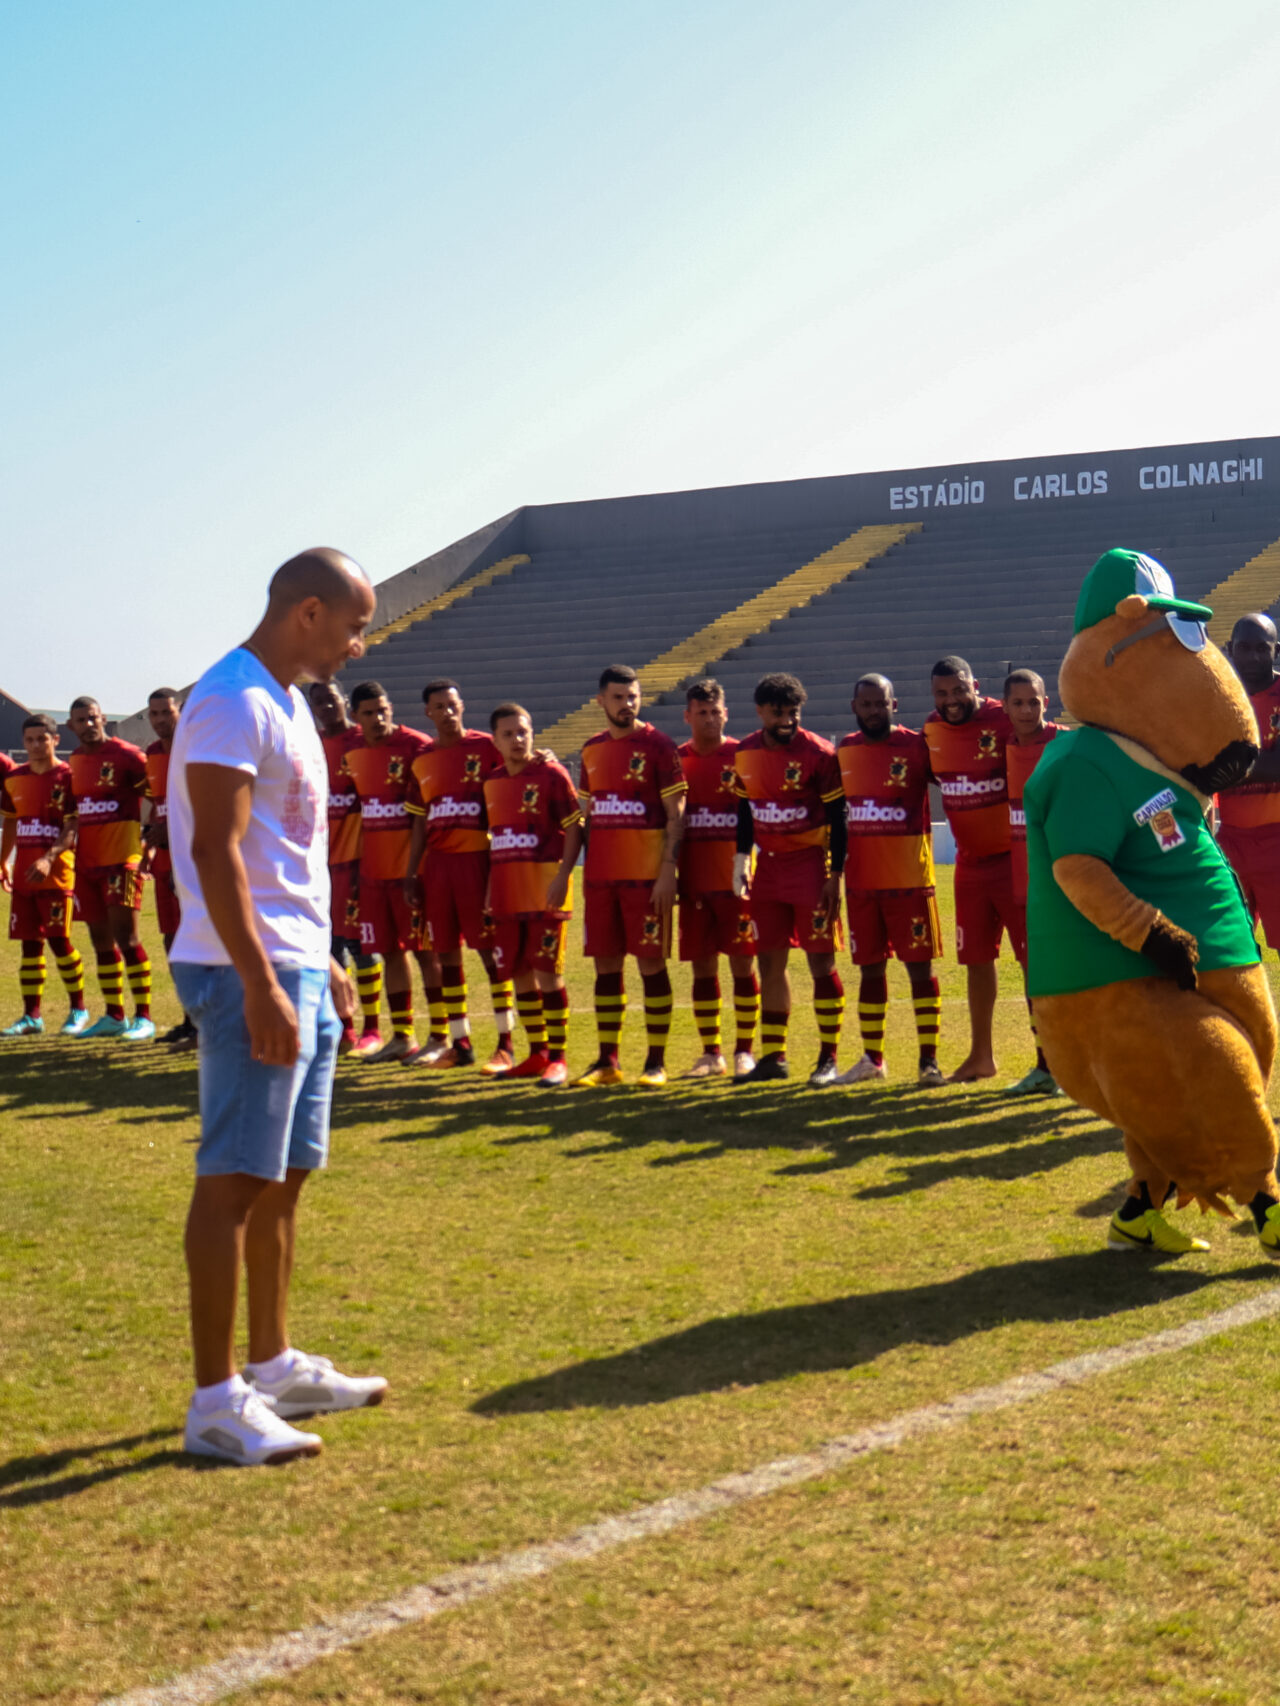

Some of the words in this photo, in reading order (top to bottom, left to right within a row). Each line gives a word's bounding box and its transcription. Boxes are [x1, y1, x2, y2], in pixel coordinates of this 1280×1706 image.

[889, 476, 985, 510] ESTÁDIO
[1014, 470, 1108, 500] CARLOS
[1139, 458, 1263, 490] COLNAGHI
[937, 775, 1005, 796] uibao
[361, 798, 408, 818] uibao
[687, 807, 738, 827] uibao
[491, 828, 539, 850] uibao
